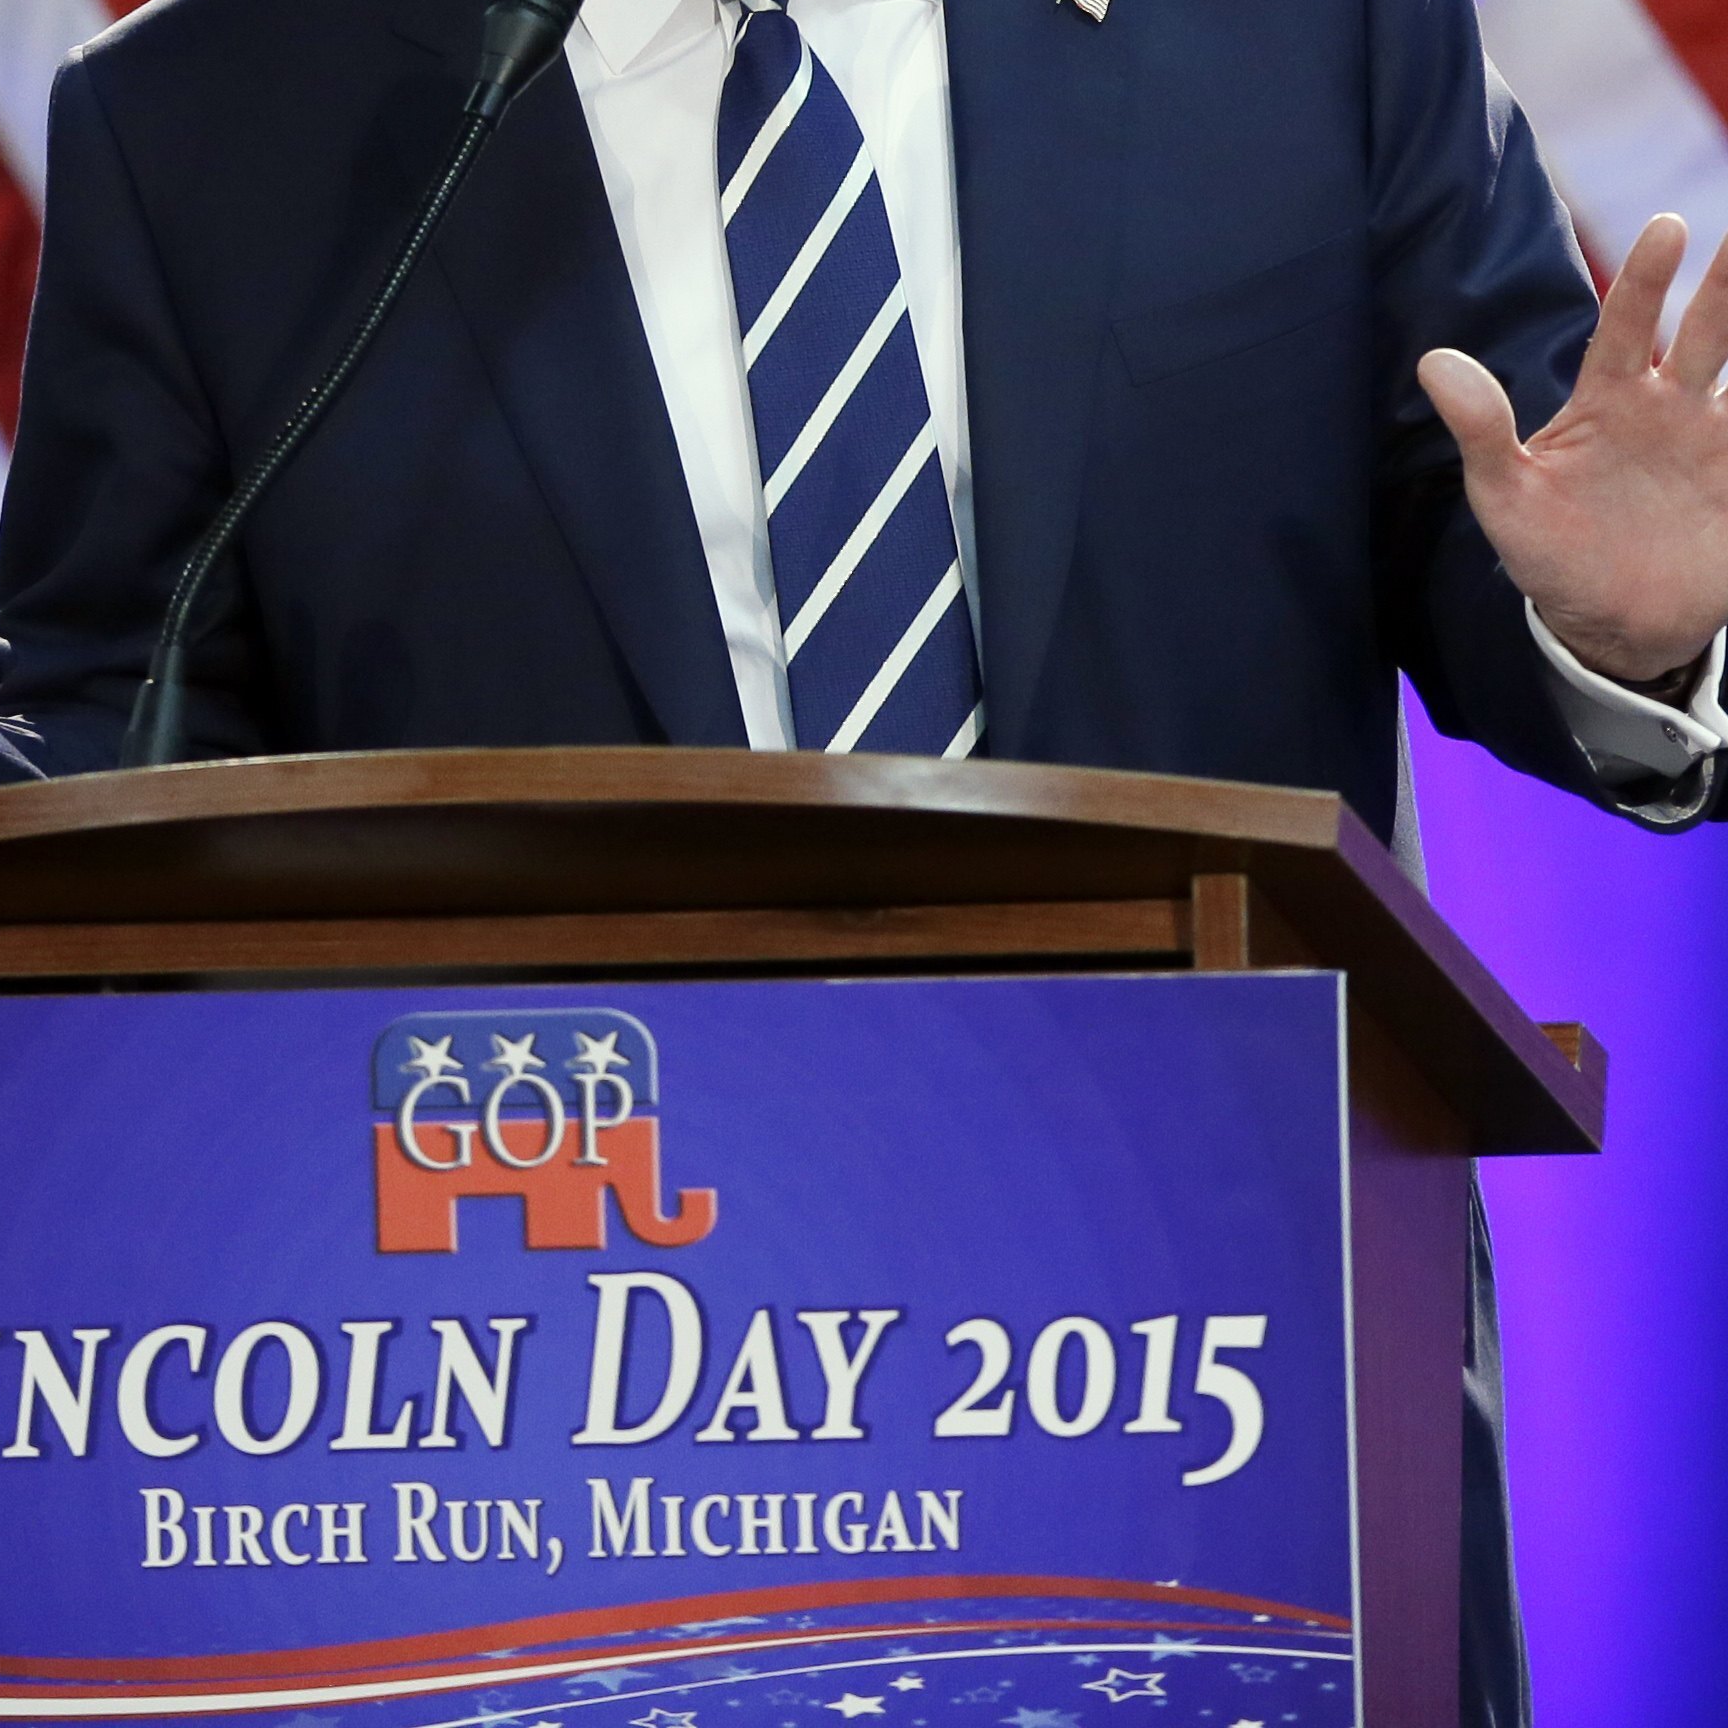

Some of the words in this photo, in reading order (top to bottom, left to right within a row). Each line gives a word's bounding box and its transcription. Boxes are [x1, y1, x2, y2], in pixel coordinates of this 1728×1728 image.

[397, 1073, 634, 1170] GOP
[571, 1271, 900, 1445] DAY
[934, 1314, 1269, 1487] 2015
[139, 1487, 368, 1570] BIRCH
[391, 1482, 564, 1575] RUN,
[585, 1476, 964, 1558] MICHIGAN
